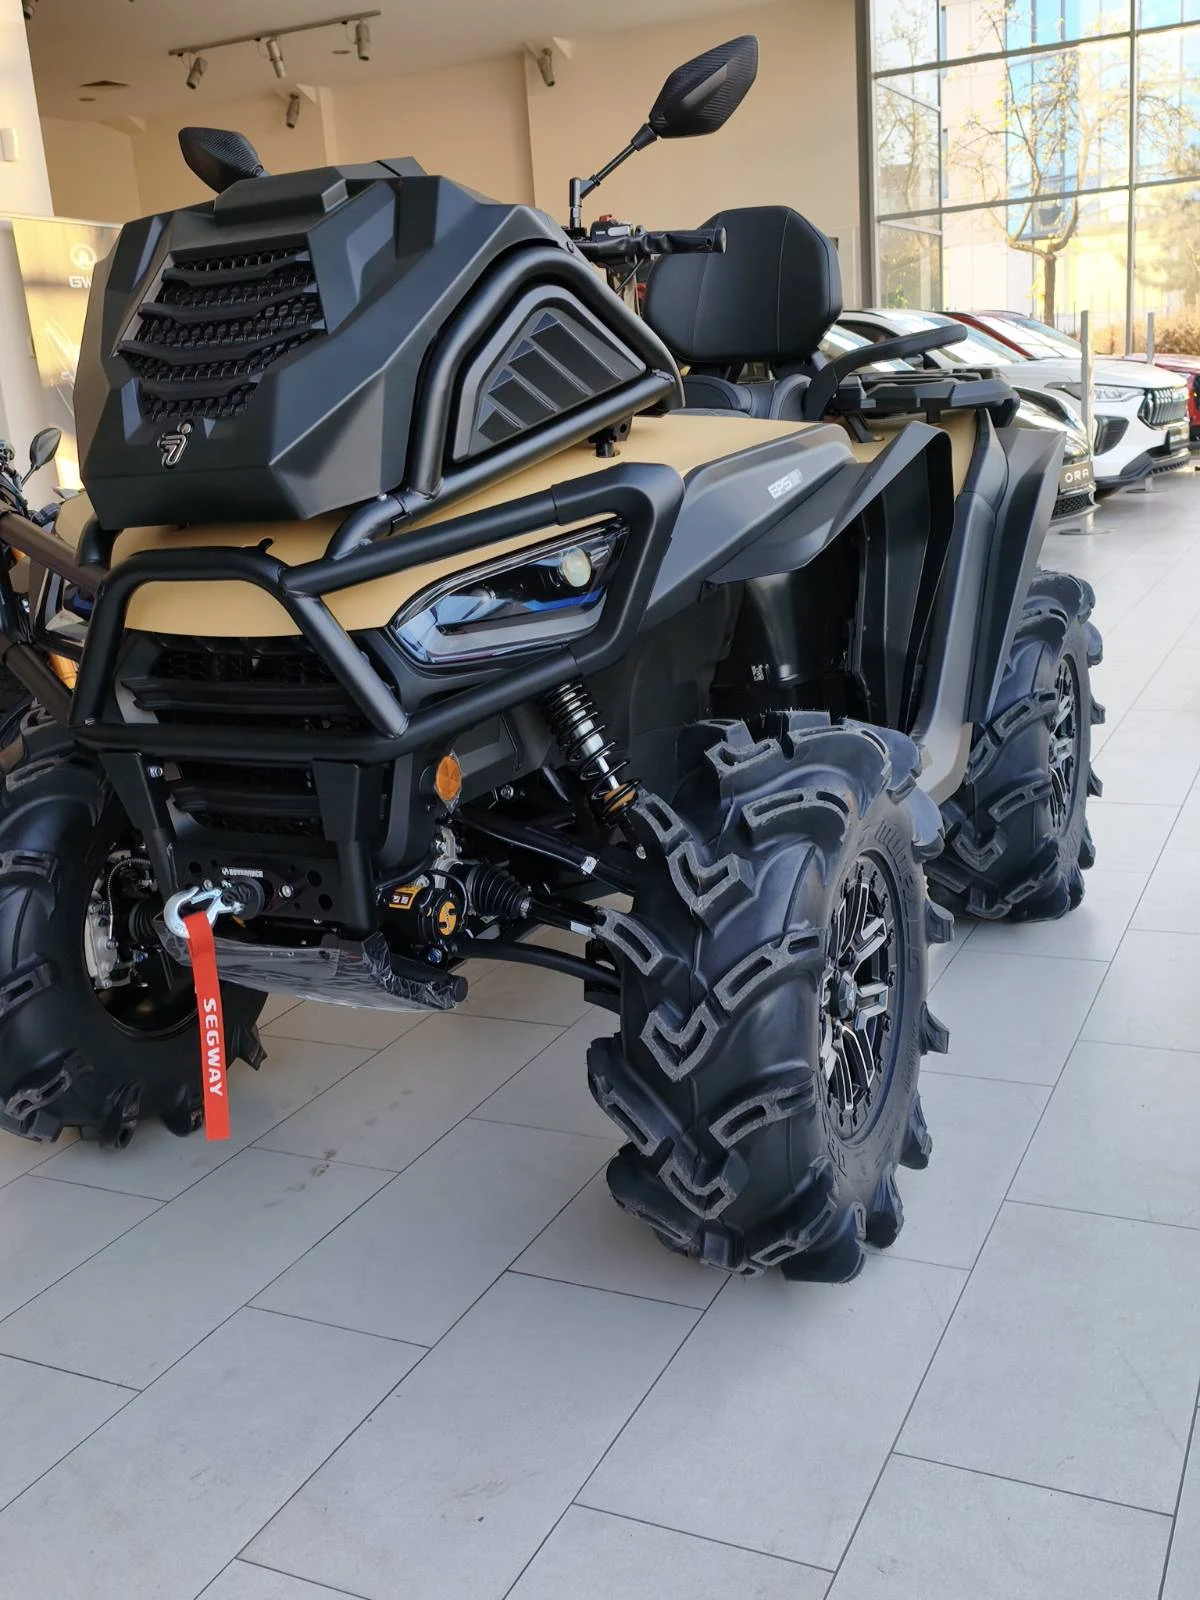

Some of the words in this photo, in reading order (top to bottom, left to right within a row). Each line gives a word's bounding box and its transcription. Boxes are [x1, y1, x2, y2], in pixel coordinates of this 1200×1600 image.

[69, 275, 93, 289] GW
[1065, 468, 1090, 484] ORA
[203, 998, 223, 1097] SEGWAY
